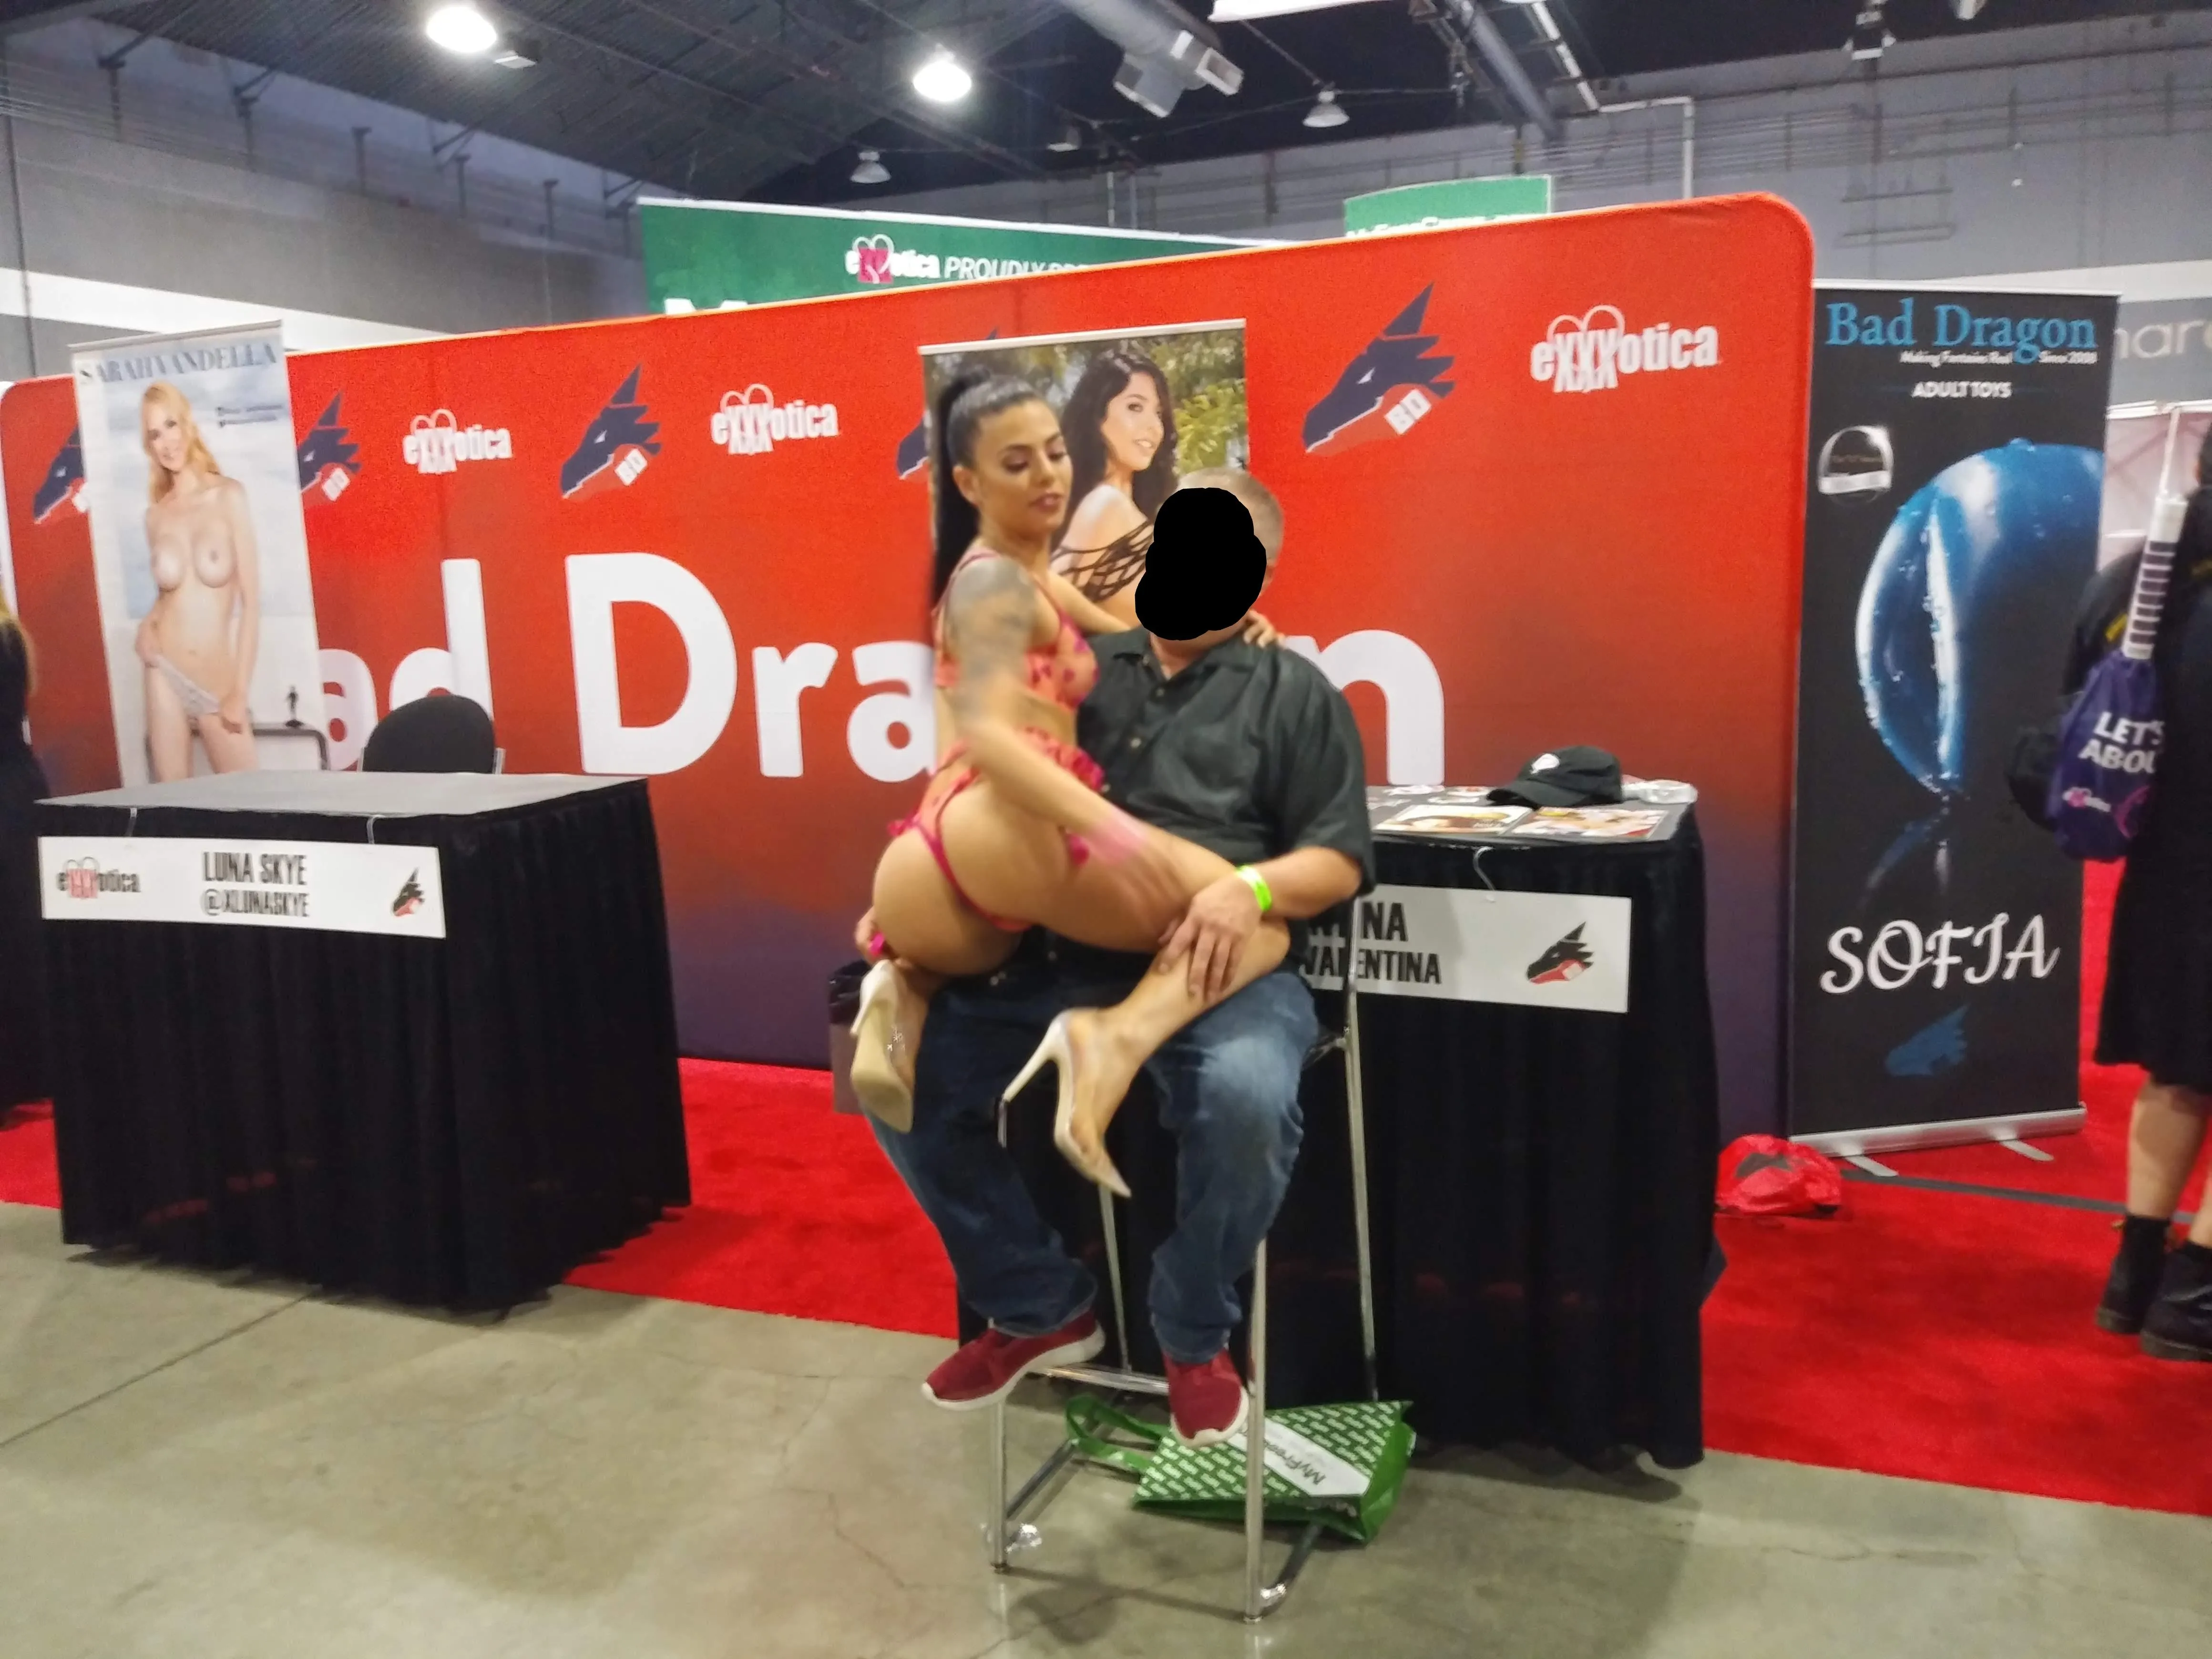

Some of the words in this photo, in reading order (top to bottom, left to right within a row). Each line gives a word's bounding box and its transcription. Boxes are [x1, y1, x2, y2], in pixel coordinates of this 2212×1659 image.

[1826, 297, 1917, 347] Bad
[1934, 304, 2099, 364] Dragon
[1912, 380, 1969, 399] ADULT
[1971, 380, 2013, 399] TOYS
[317, 558, 496, 772] ad
[204, 851, 255, 882] LUNA
[260, 853, 308, 885] SKYE
